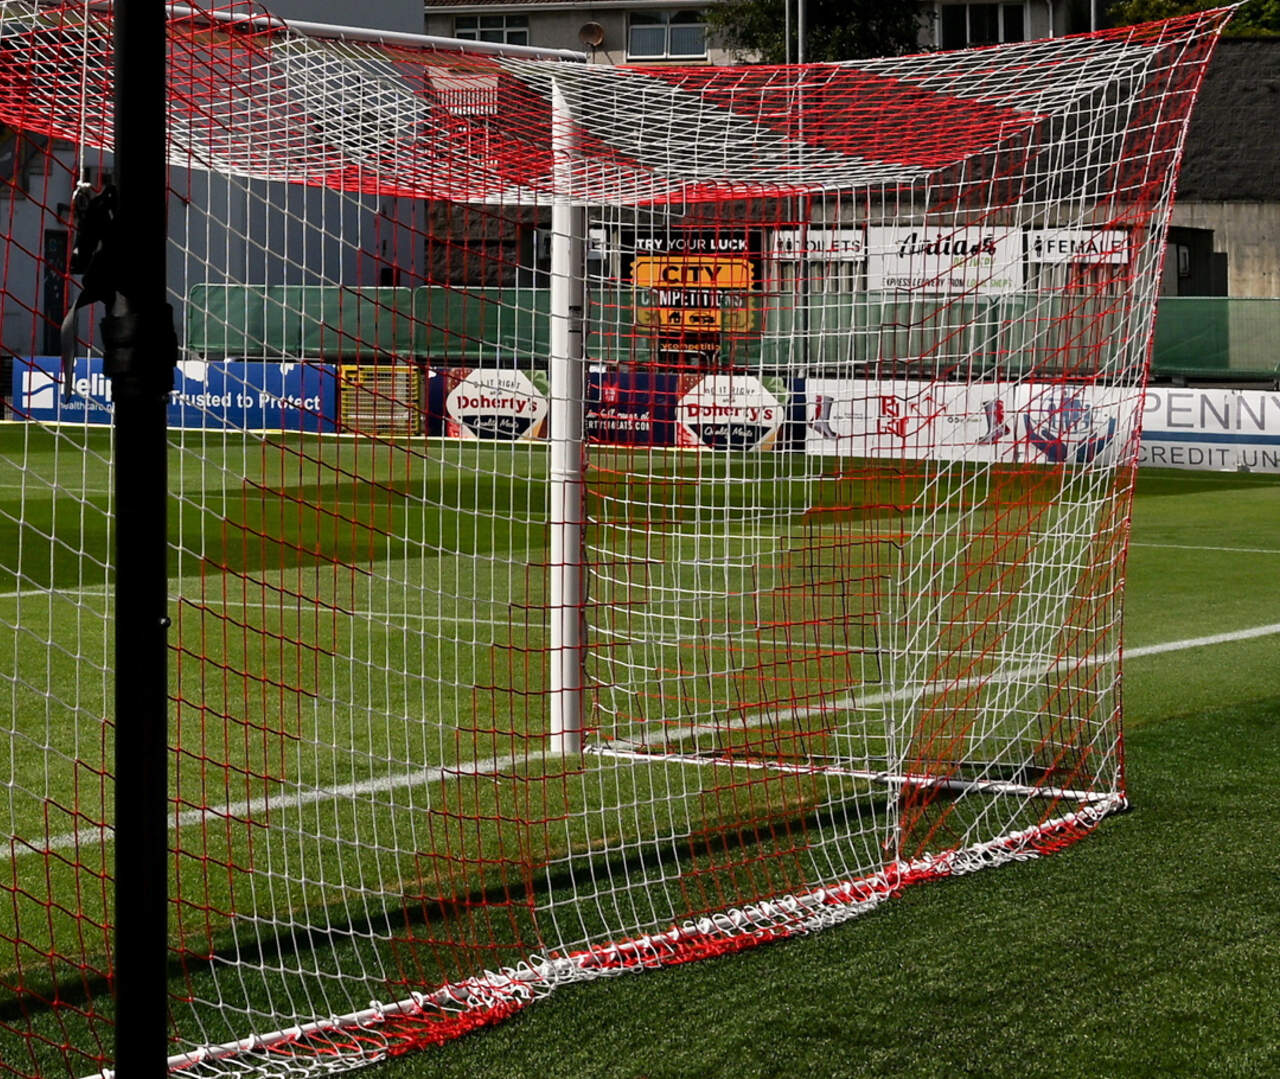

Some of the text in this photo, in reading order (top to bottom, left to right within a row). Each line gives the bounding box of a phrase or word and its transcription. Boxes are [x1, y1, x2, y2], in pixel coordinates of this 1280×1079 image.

[636, 239, 748, 250] TRY YOUR LUCK
[662, 265, 722, 284] CITY
[171, 391, 321, 410] Trusted to Protect
[457, 395, 538, 414] Doherty's
[687, 403, 773, 421] Dohery's
[1138, 444, 1230, 466] CREDIT
